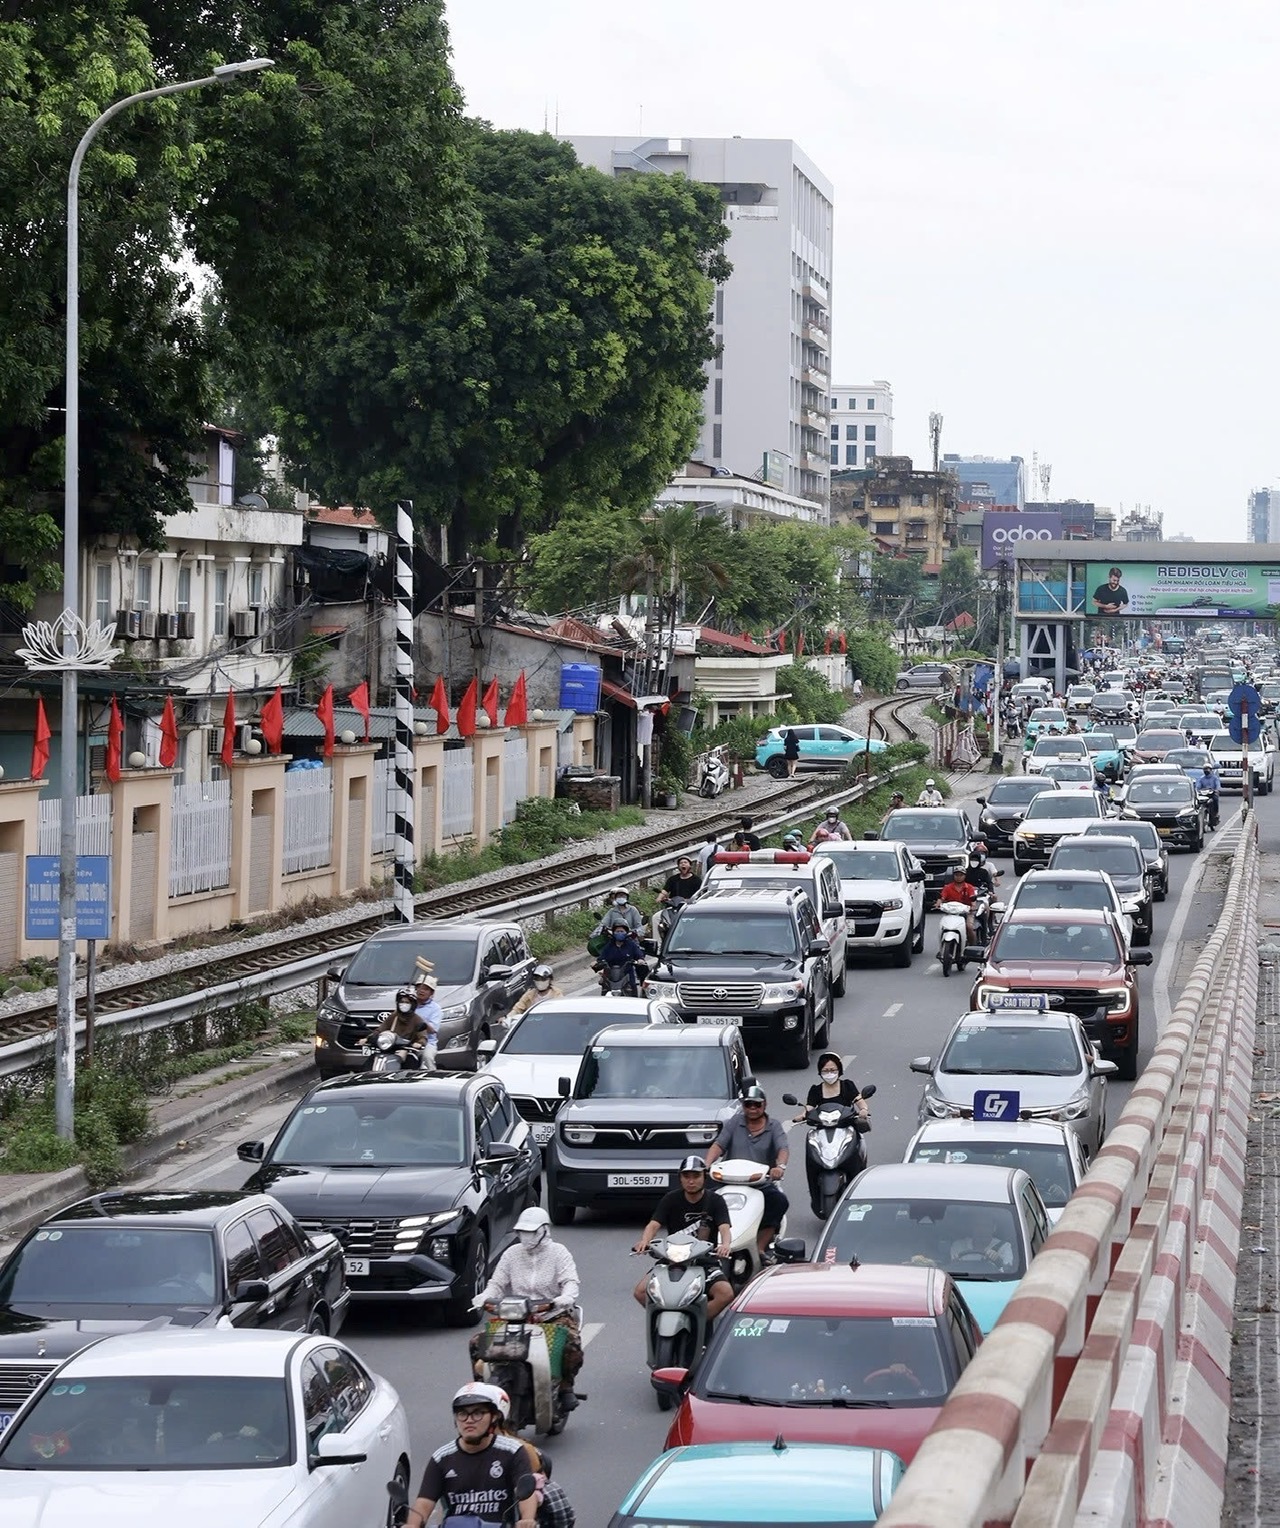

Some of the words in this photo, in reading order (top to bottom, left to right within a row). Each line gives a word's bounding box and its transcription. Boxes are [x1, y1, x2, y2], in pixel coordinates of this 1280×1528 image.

[992, 524, 1053, 544] odoo
[1157, 566, 1229, 578] REDISOLV
[1231, 567, 1247, 578] Gel
[1004, 999, 1017, 1008] SAO
[984, 1093, 1009, 1118] G7
[612, 1176, 664, 1186] 30L-558.77
[825, 1246, 838, 1264] TAX
[733, 1326, 764, 1337] TAXI
[447, 1488, 508, 1505] Emirates
